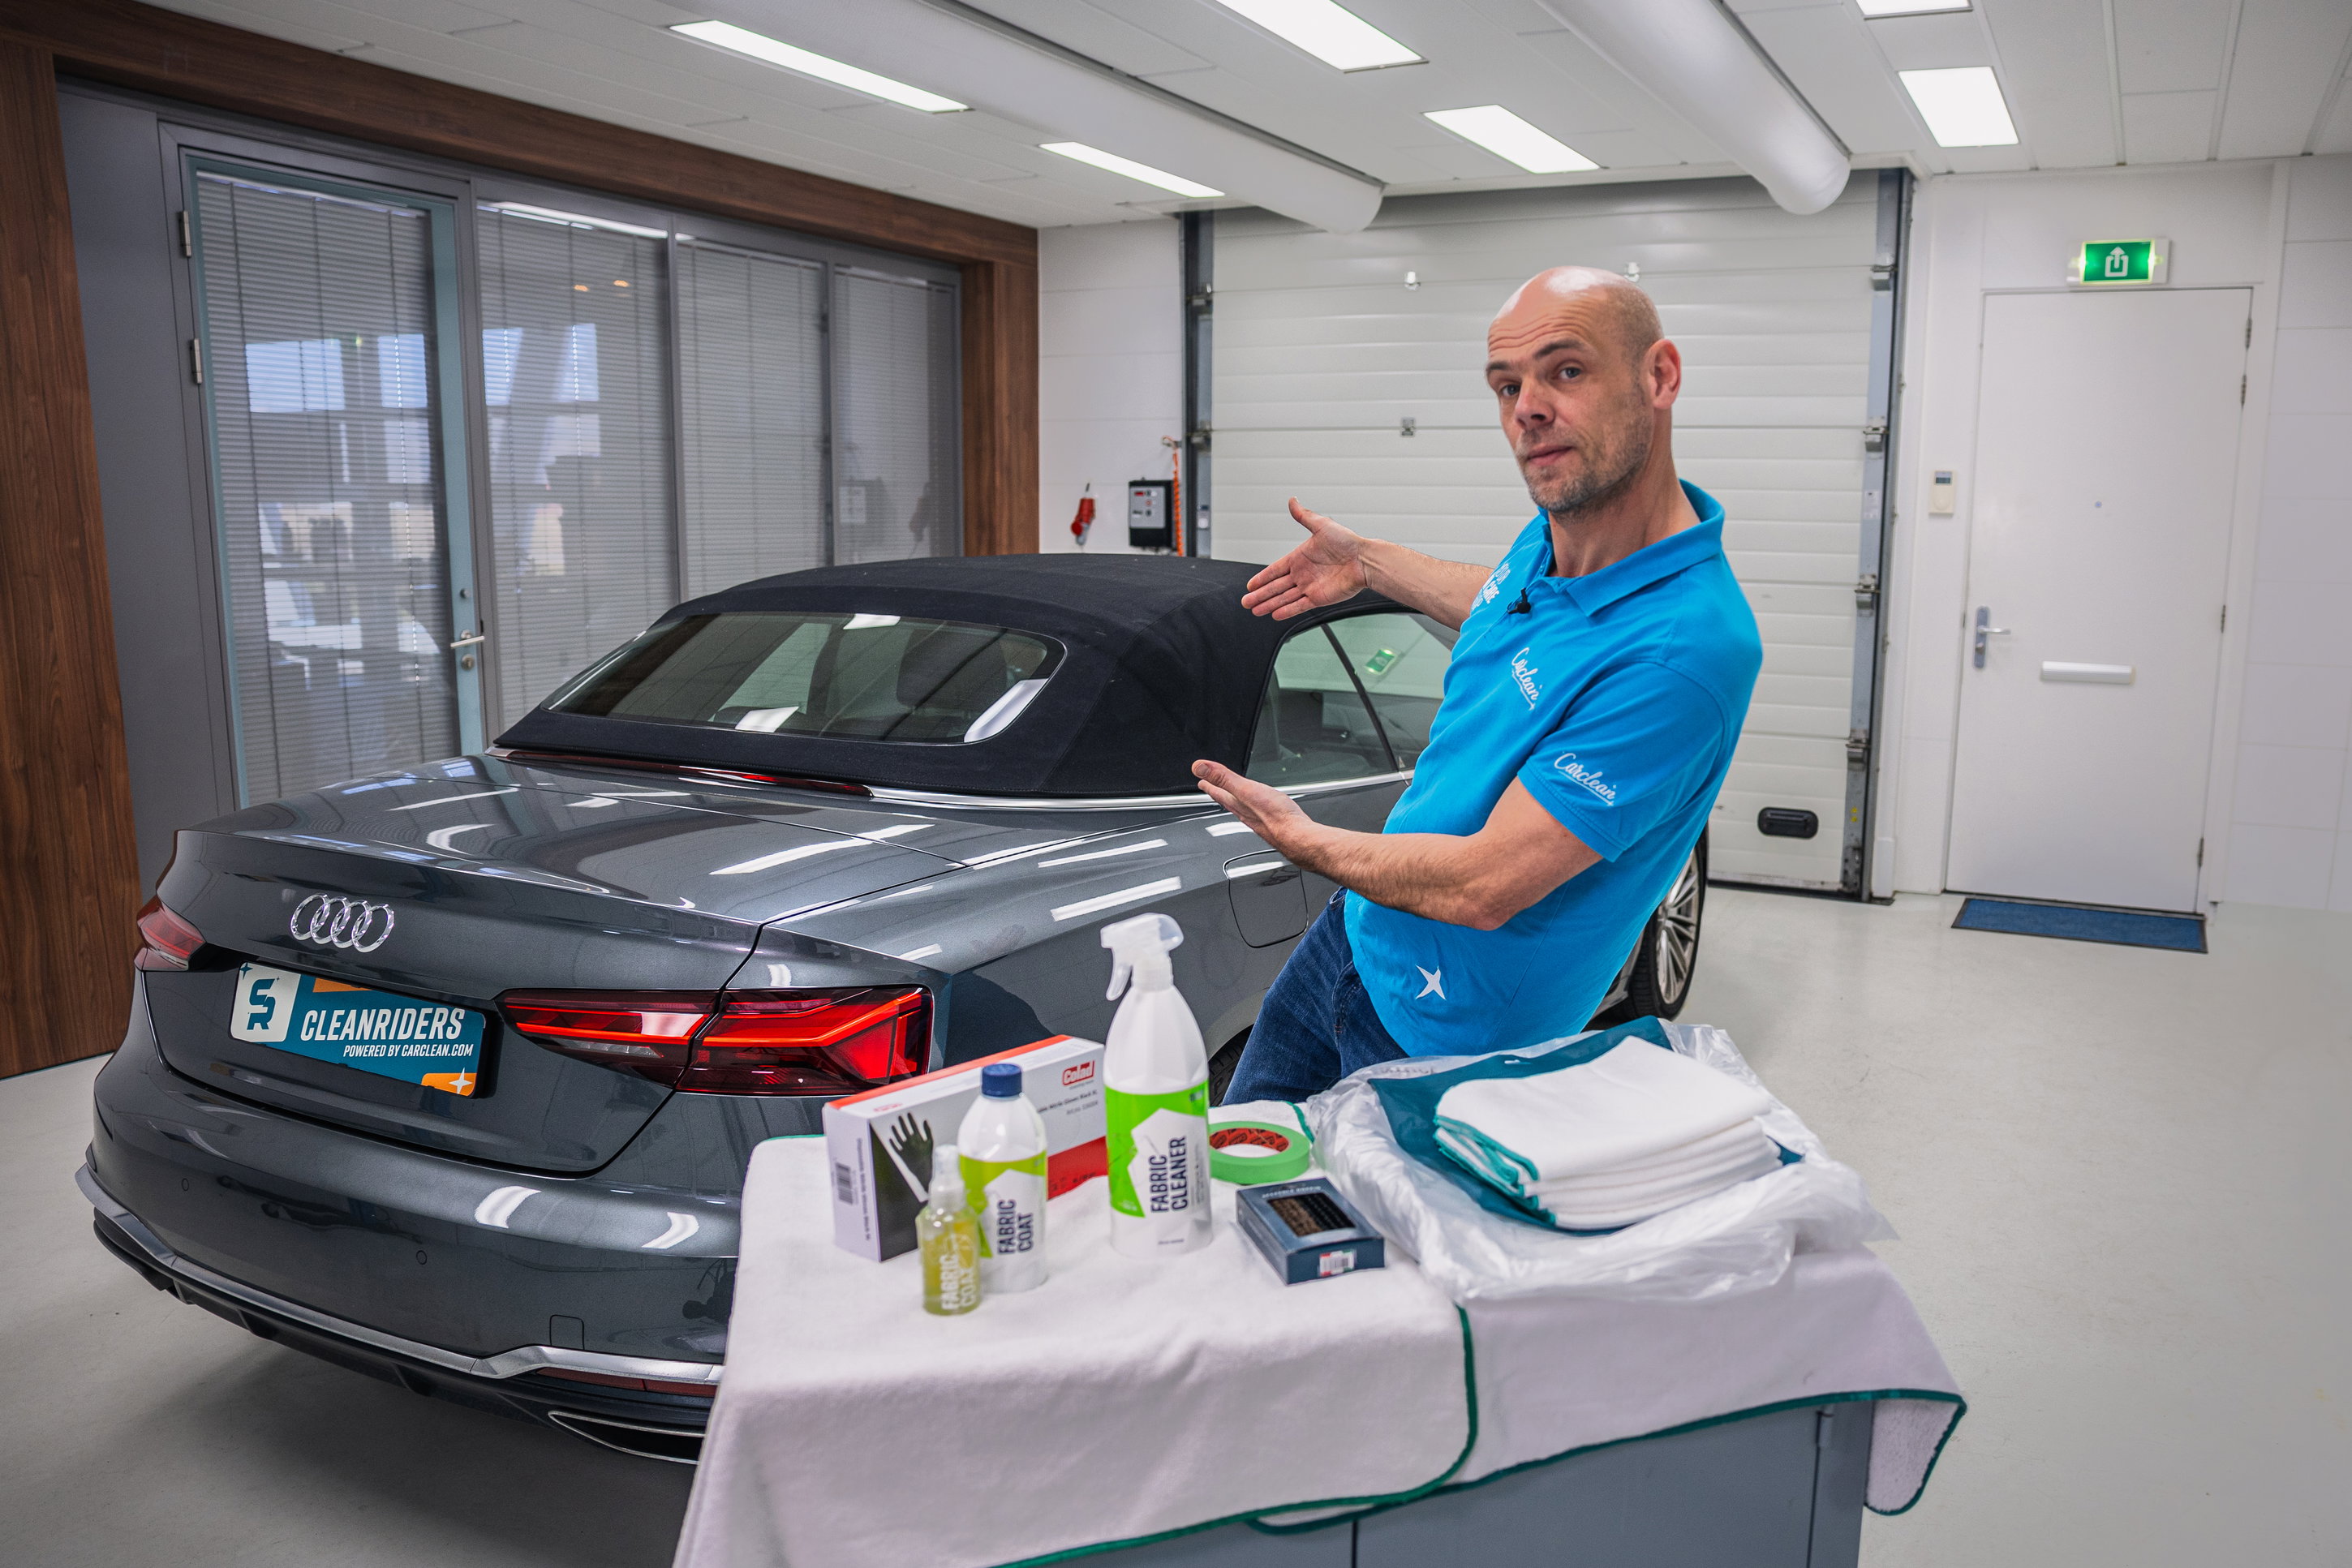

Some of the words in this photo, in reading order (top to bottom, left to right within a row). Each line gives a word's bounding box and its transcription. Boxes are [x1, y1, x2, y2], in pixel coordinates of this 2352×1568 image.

[1554, 753, 1617, 801] Carclean
[300, 1007, 466, 1042] CLEANRIDERS
[343, 1044, 387, 1058] POWERED
[388, 1044, 401, 1057] BY
[402, 1043, 474, 1057] CARCLEAN.COM
[1149, 1154, 1169, 1212] FABRIC
[1169, 1136, 1189, 1211] CLEANER
[998, 1199, 1017, 1254] FABRIC
[1017, 1212, 1034, 1252] COAT
